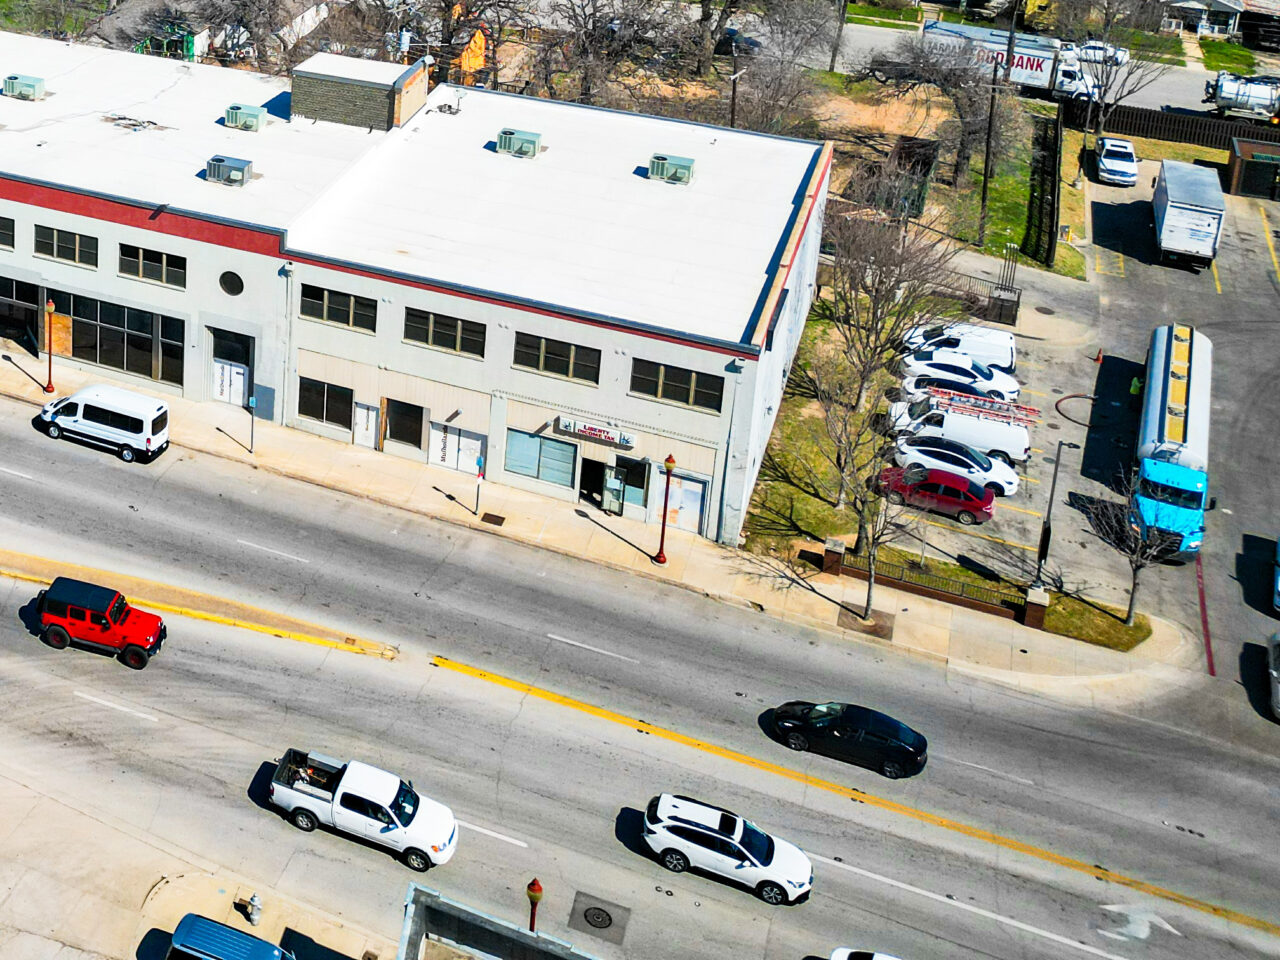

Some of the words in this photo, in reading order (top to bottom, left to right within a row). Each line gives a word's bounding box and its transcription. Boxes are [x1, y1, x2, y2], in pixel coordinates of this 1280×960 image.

[577, 429, 602, 438] INCOME
[604, 434, 615, 442] TAX
[583, 424, 610, 435] LIBERTY
